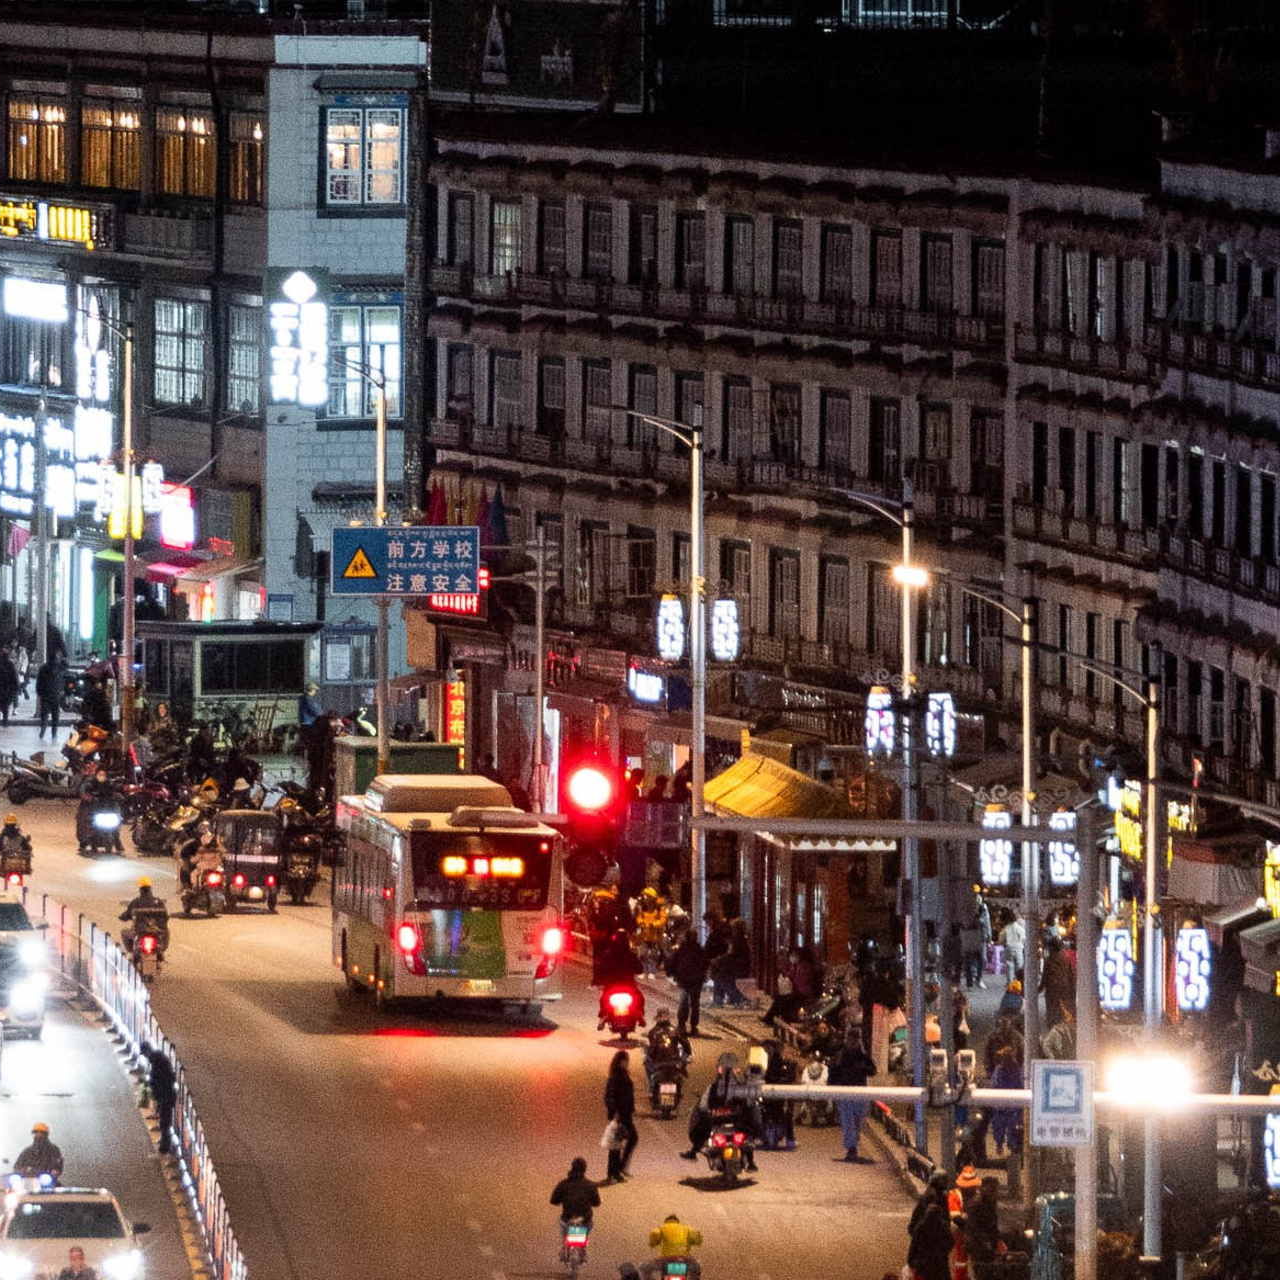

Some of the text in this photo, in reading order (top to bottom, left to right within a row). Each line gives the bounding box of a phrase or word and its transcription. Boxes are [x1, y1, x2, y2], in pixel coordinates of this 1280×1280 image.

[387, 540, 473, 559] 前方学校
[387, 573, 472, 592] 注意安全
